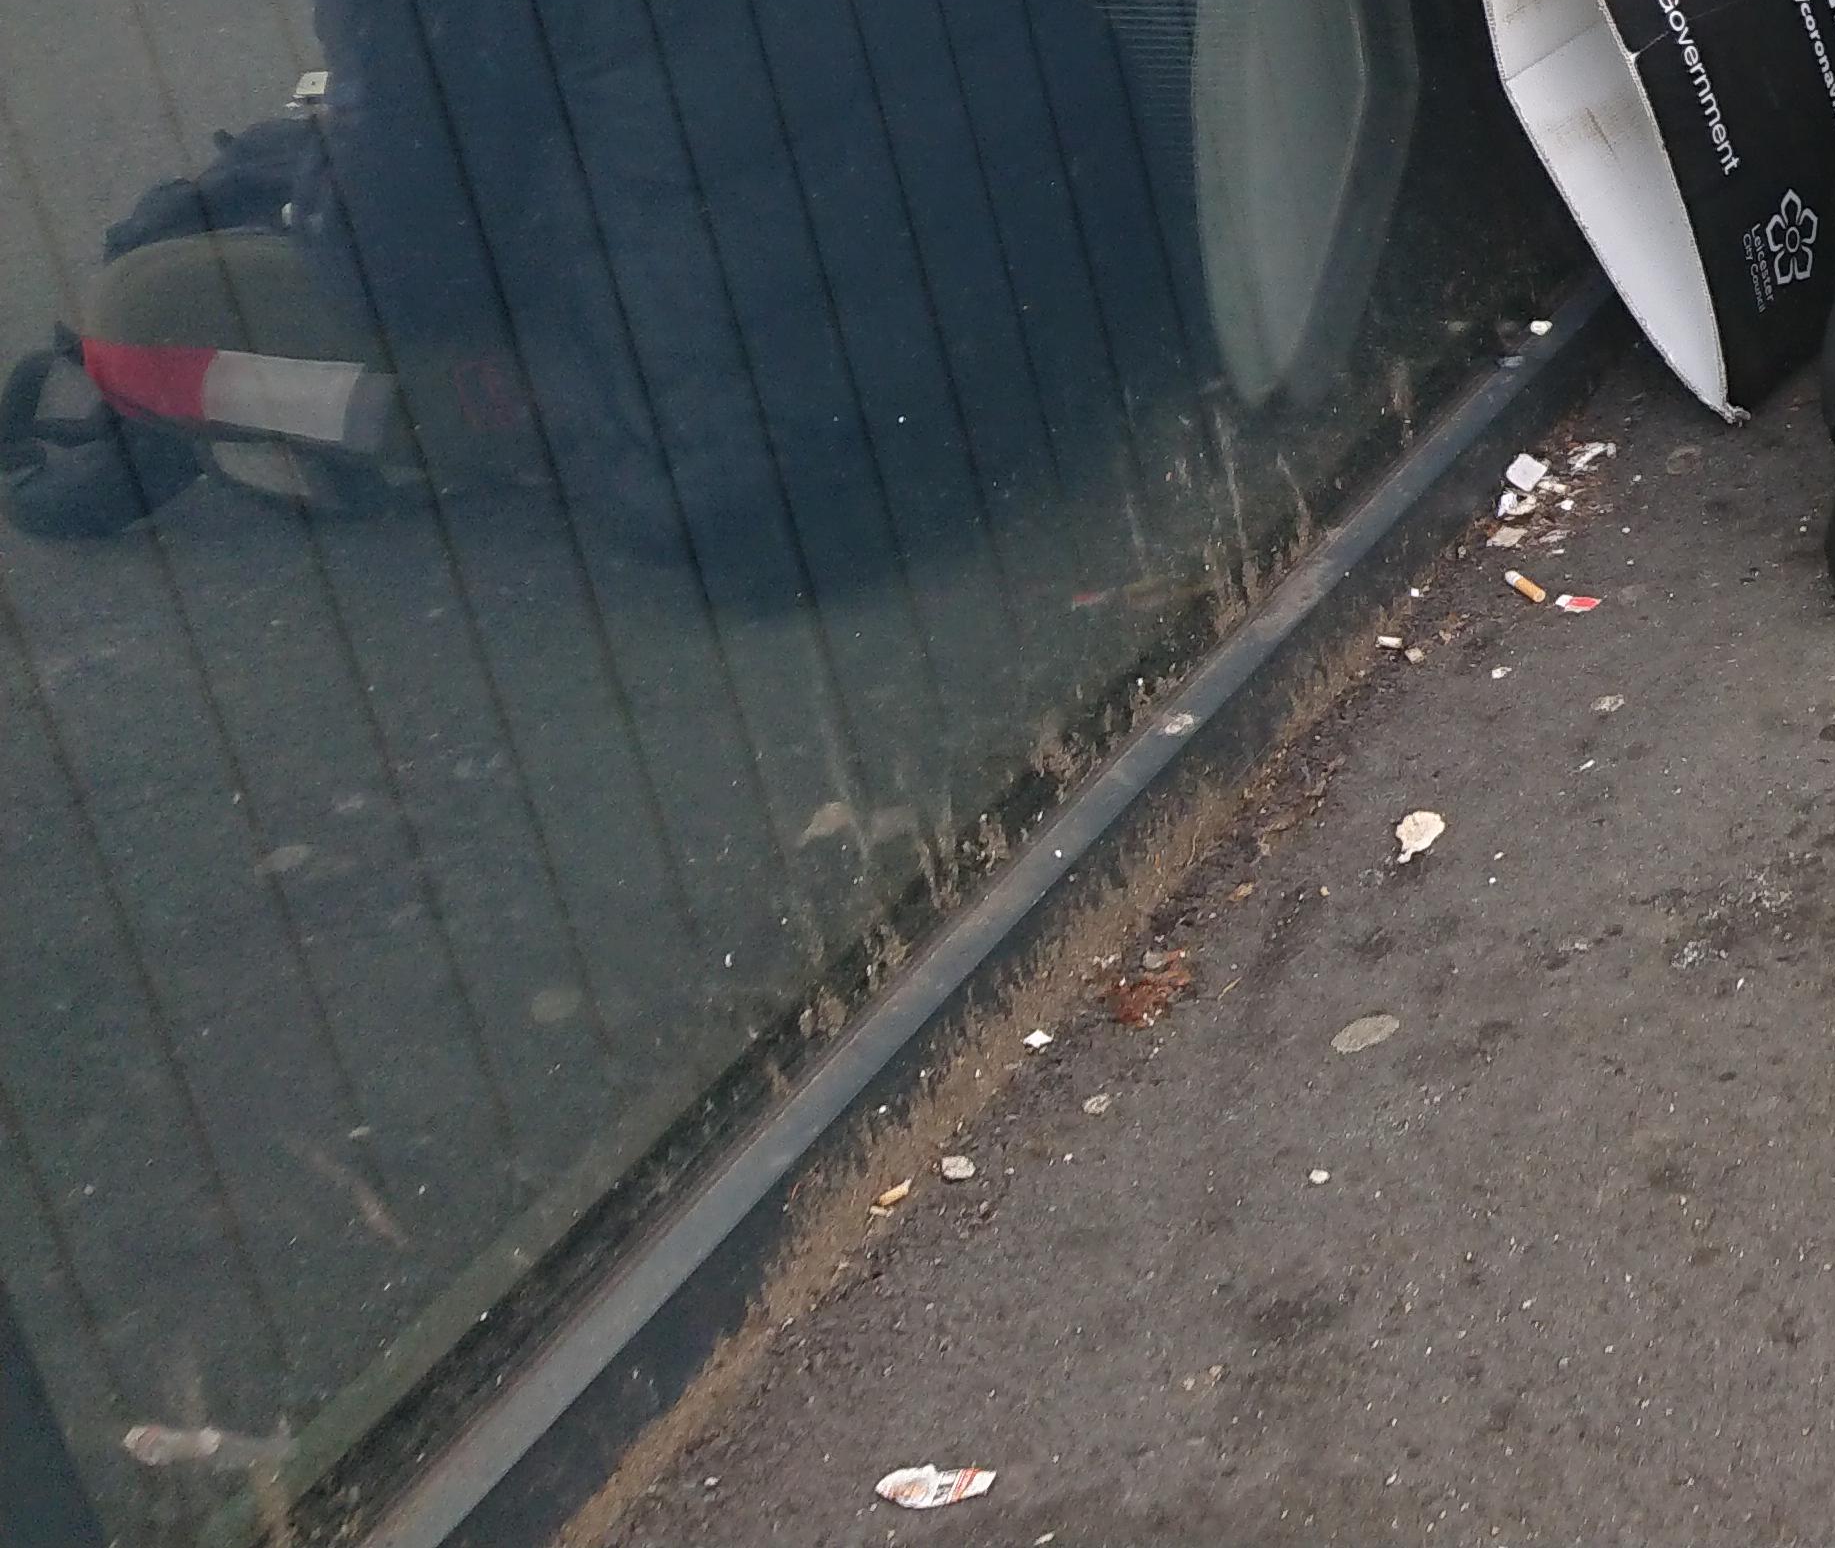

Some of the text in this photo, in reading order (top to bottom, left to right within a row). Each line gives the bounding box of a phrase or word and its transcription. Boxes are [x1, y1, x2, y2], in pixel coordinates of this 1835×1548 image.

[1743, 233, 1766, 313] City Council
[1751, 223, 1775, 302] Leicester
